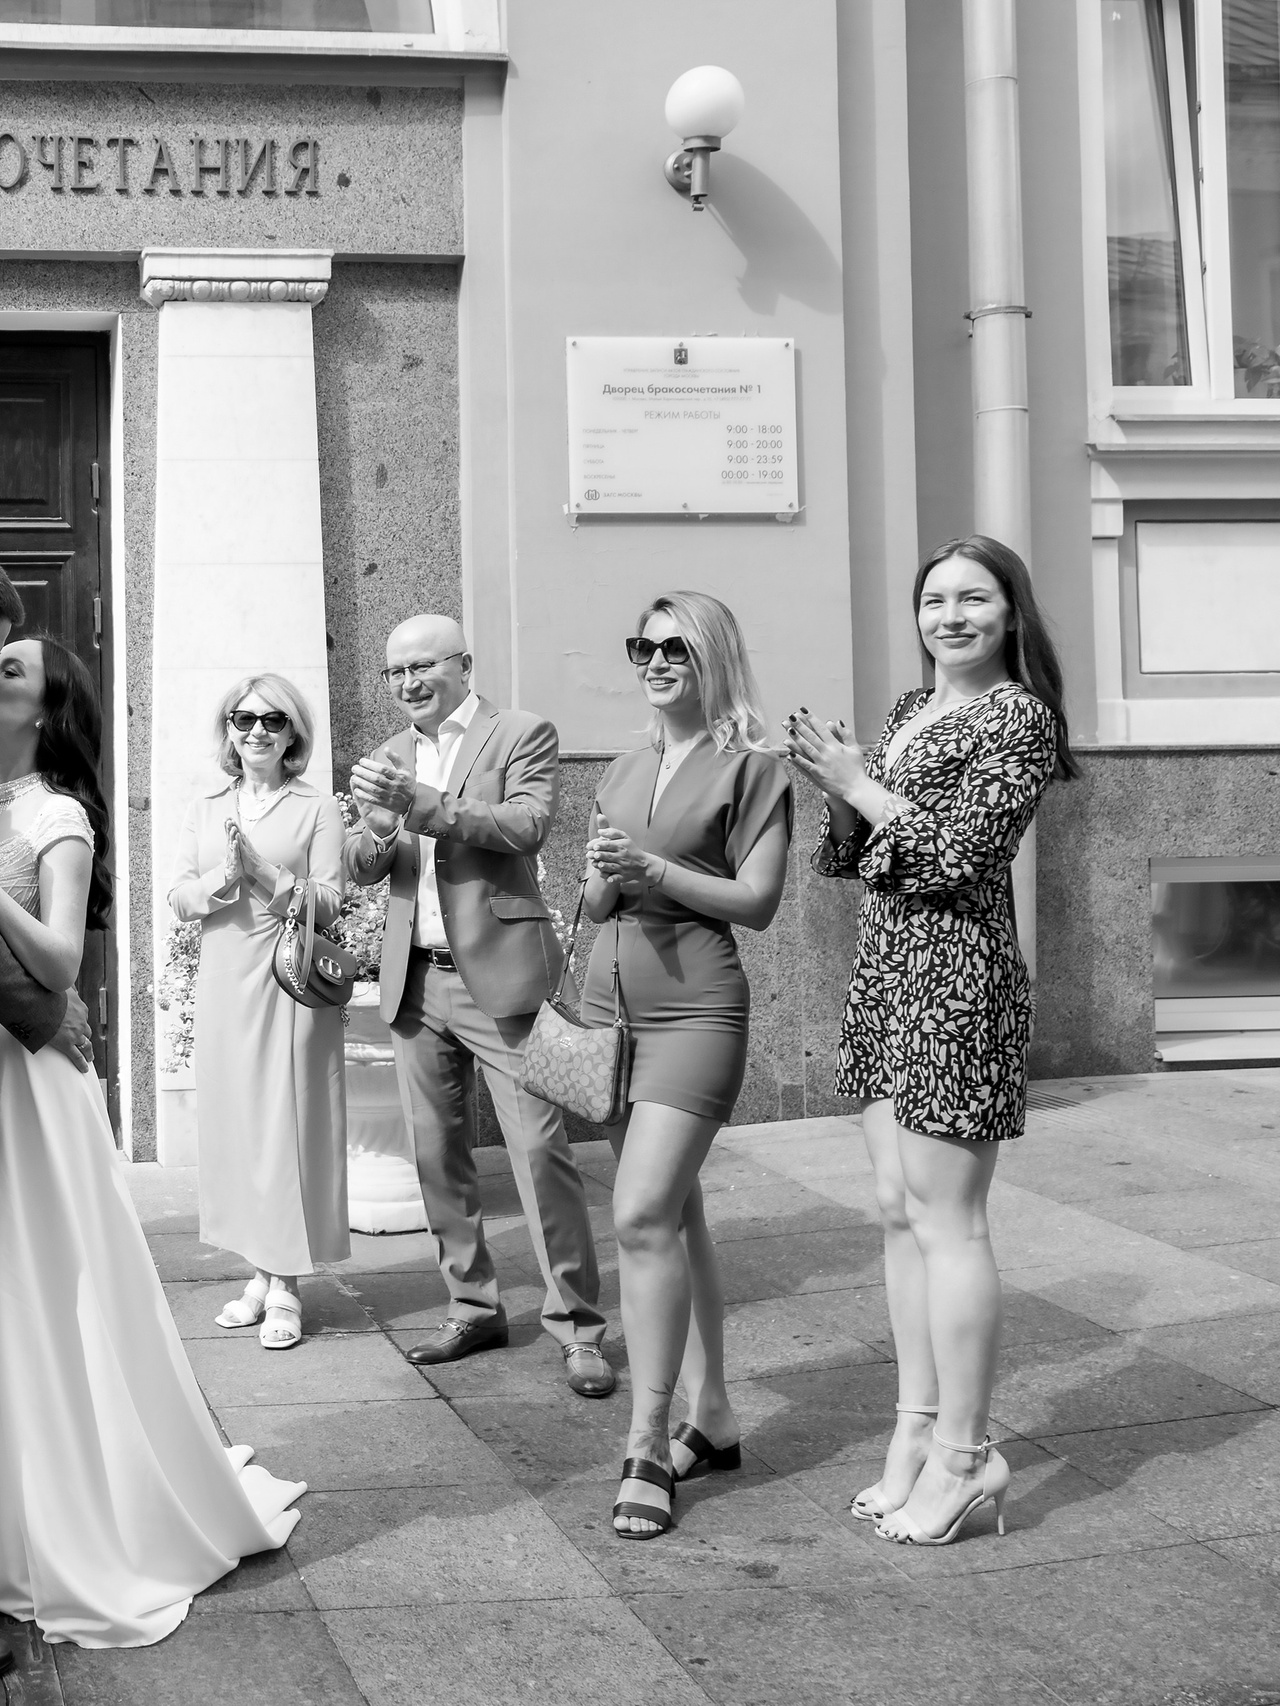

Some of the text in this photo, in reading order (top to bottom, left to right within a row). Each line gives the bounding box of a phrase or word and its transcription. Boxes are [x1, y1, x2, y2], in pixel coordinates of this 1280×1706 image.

[603, 384, 644, 395] Дворец
[647, 384, 736, 395] бракосочетания
[757, 385, 761, 394] 1
[644, 411, 720, 419] РЕЖИМ РАБОТЫ
[726, 425, 748, 433] 9:00
[758, 425, 782, 433] 18:00
[727, 440, 748, 448] 9:00
[756, 440, 783, 448] 20:00
[727, 455, 748, 463] 9:00
[756, 455, 783, 463] 23:59
[721, 471, 749, 479] 00:00
[758, 471, 783, 479] 19:00
